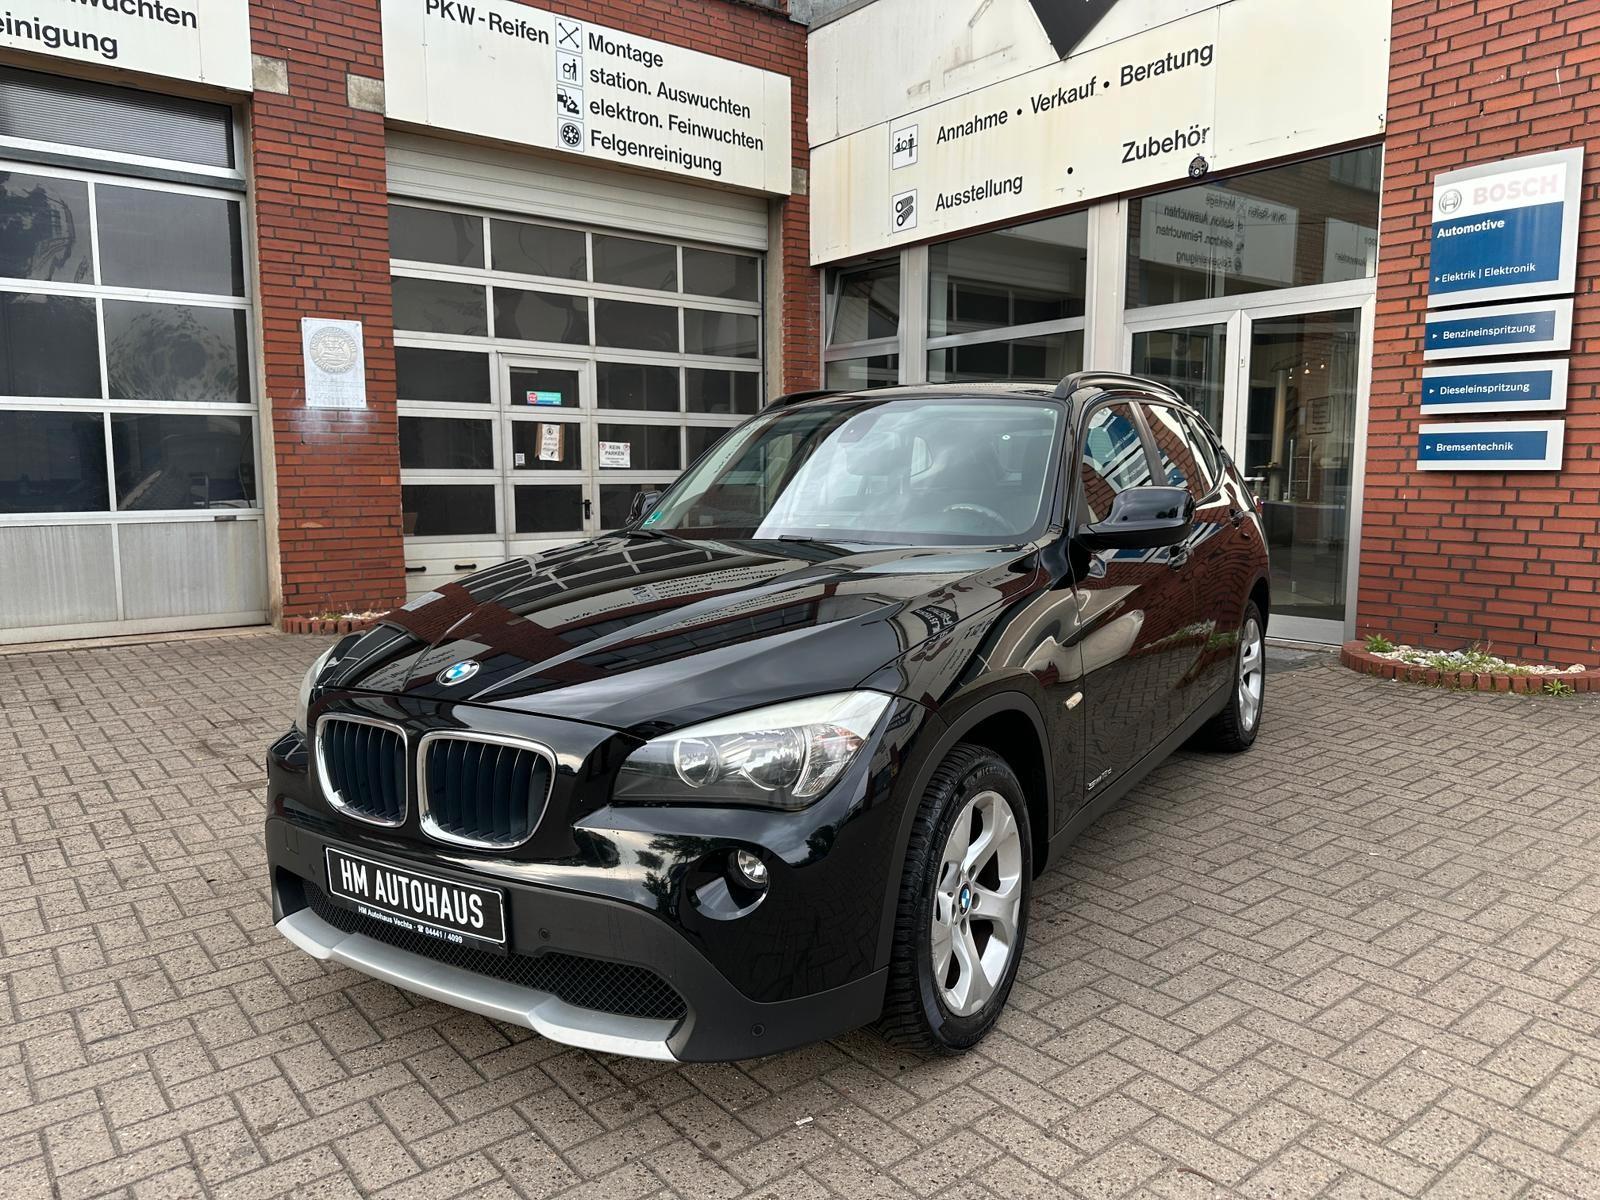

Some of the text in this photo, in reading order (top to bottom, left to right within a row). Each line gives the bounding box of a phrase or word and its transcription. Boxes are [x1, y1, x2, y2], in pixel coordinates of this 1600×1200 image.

[0, 11, 119, 60] inigung
[425, 0, 550, 45] PKW-Reifen
[588, 32, 664, 68] Montage
[589, 66, 751, 119] station. Auswuchten
[936, 42, 1214, 145] Annahme Verkauf Beratung
[589, 98, 764, 151] elektron. Feinwuchten
[1122, 123, 1211, 164] Zubehör
[590, 129, 722, 176] Felgenreinigung
[935, 173, 1024, 212] Ausstellung
[1472, 174, 1558, 206] BOSCH
[1436, 218, 1505, 239] Automotive
[1441, 269, 1476, 283] Elektrik
[1484, 263, 1536, 278] Elektronik
[1443, 323, 1536, 341] Benzineinspritzung
[1439, 382, 1530, 396] Dieseleinspritzung
[1436, 441, 1514, 452] Bremsentechnik
[340, 858, 484, 929] HM AUTOHAUS
[368, 908, 393, 923] Autohaus
[393, 917, 413, 930] Vechta
